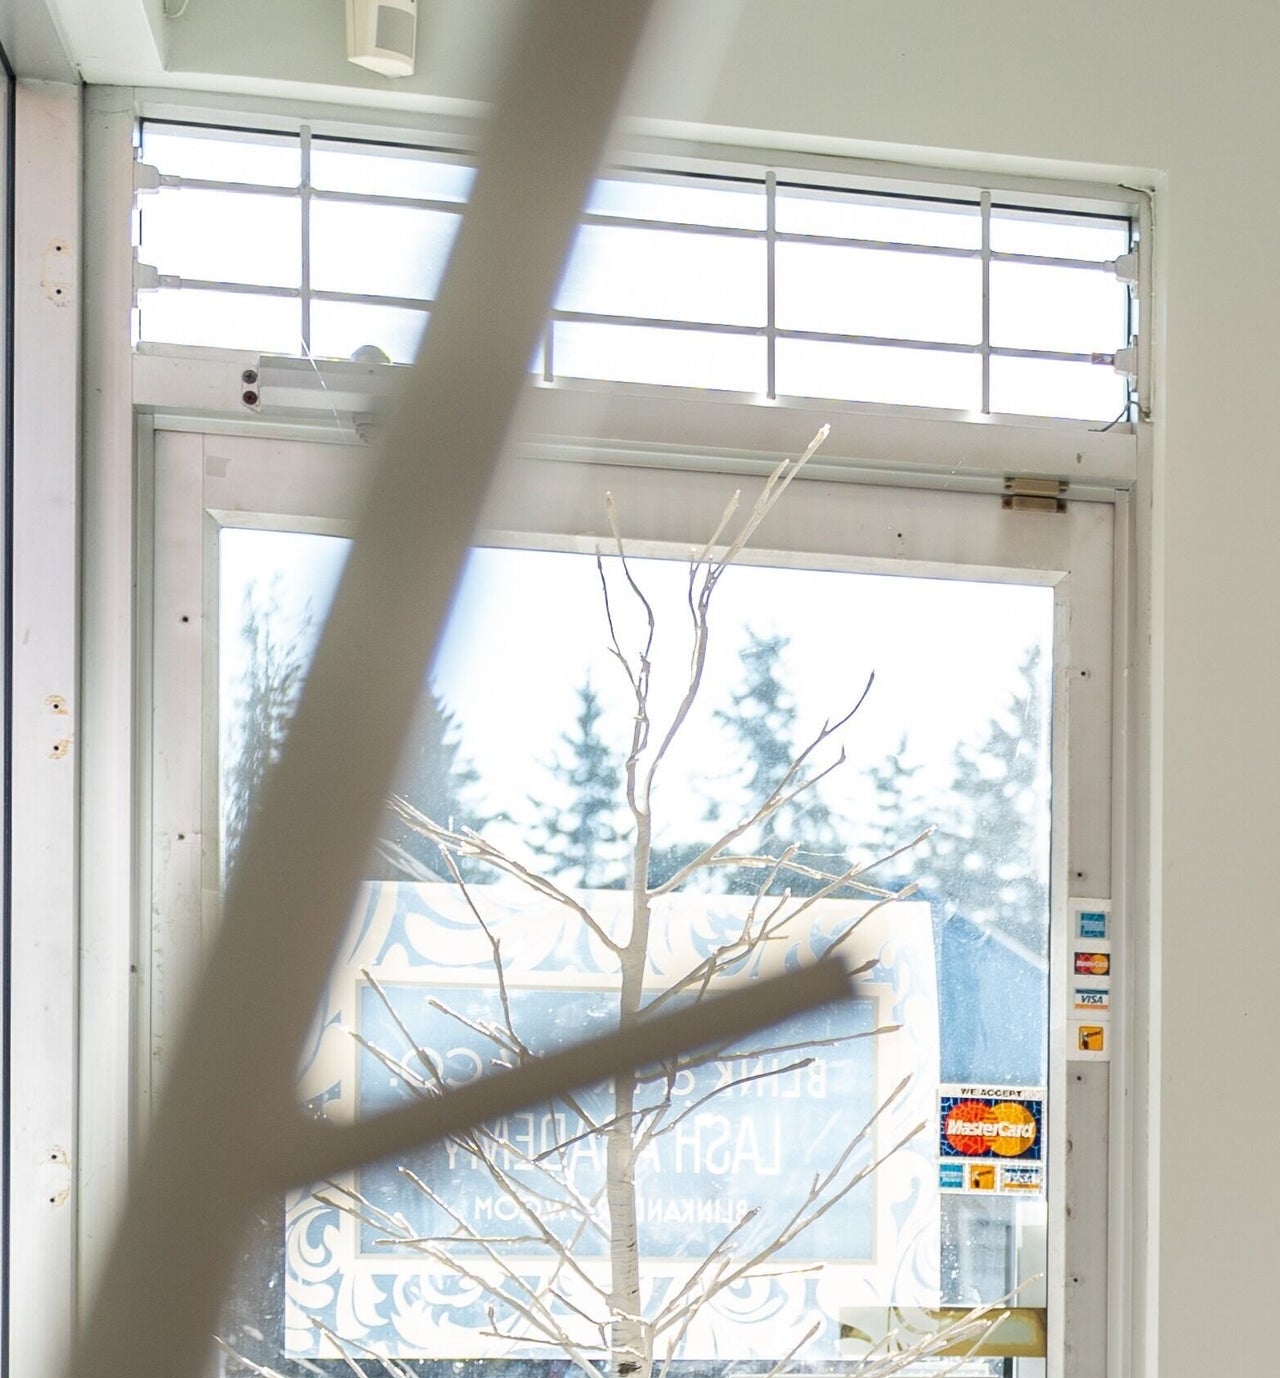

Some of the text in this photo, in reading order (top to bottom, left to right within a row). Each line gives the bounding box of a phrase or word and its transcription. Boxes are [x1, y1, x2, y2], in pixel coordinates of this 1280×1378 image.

[1081, 995, 1104, 1004] VISA
[981, 1089, 1023, 1097] ACCEPT
[946, 1119, 1036, 1139] MasterCard
